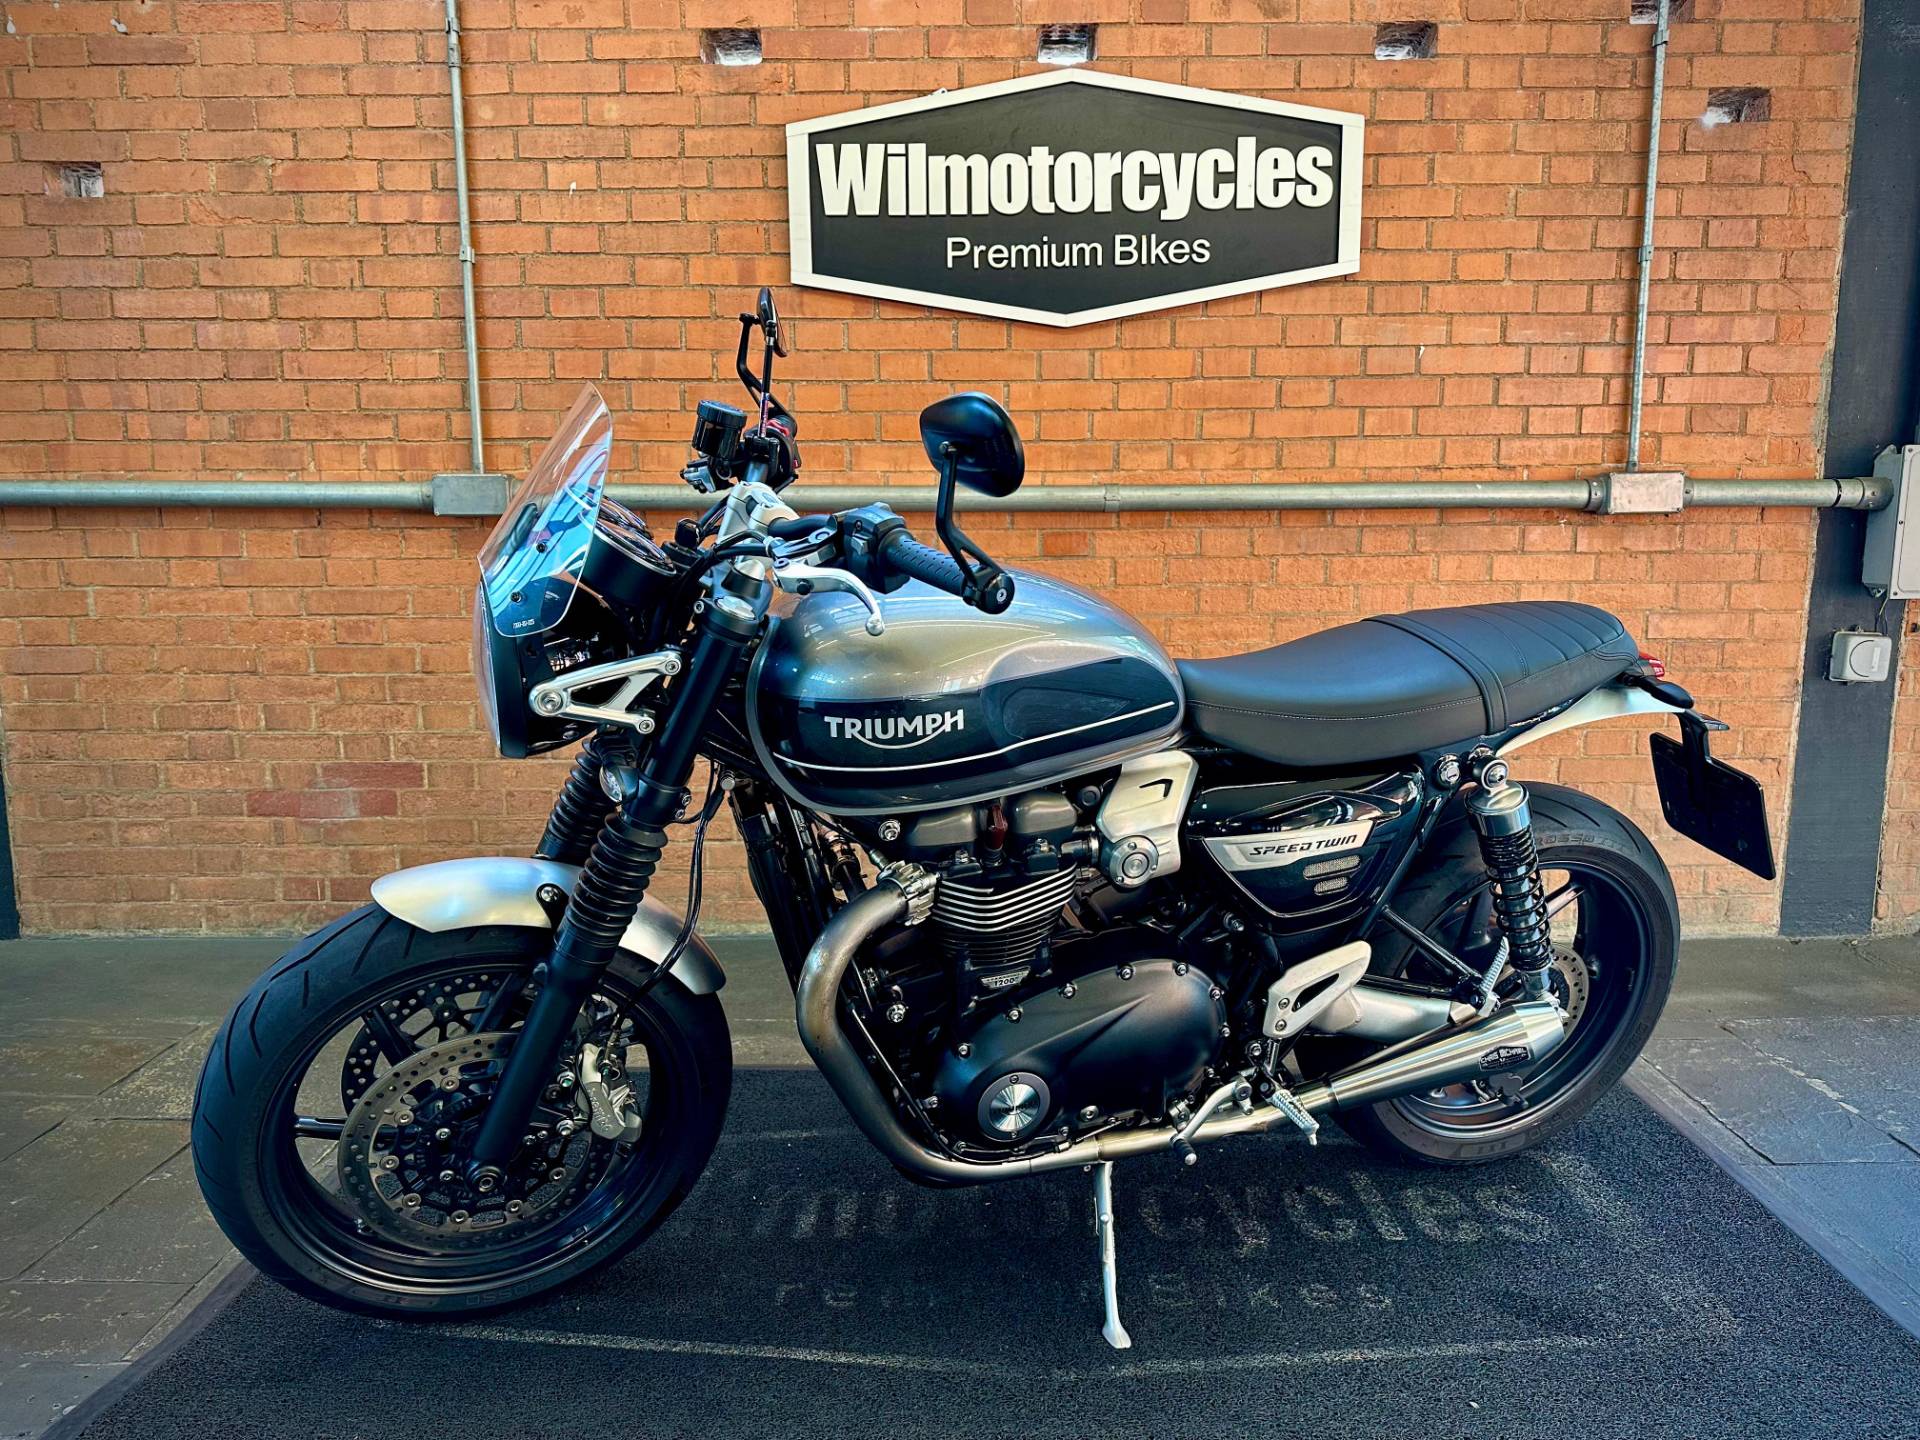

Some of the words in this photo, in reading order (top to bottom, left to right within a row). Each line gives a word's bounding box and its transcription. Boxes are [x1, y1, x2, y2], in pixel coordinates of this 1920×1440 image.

[815, 136, 1334, 221] Wilmotorcycles
[946, 237, 1103, 269] Premium
[824, 708, 964, 747] TRIUMPH
[1250, 843, 1313, 856] SPEED
[1315, 834, 1357, 850] TWIN
